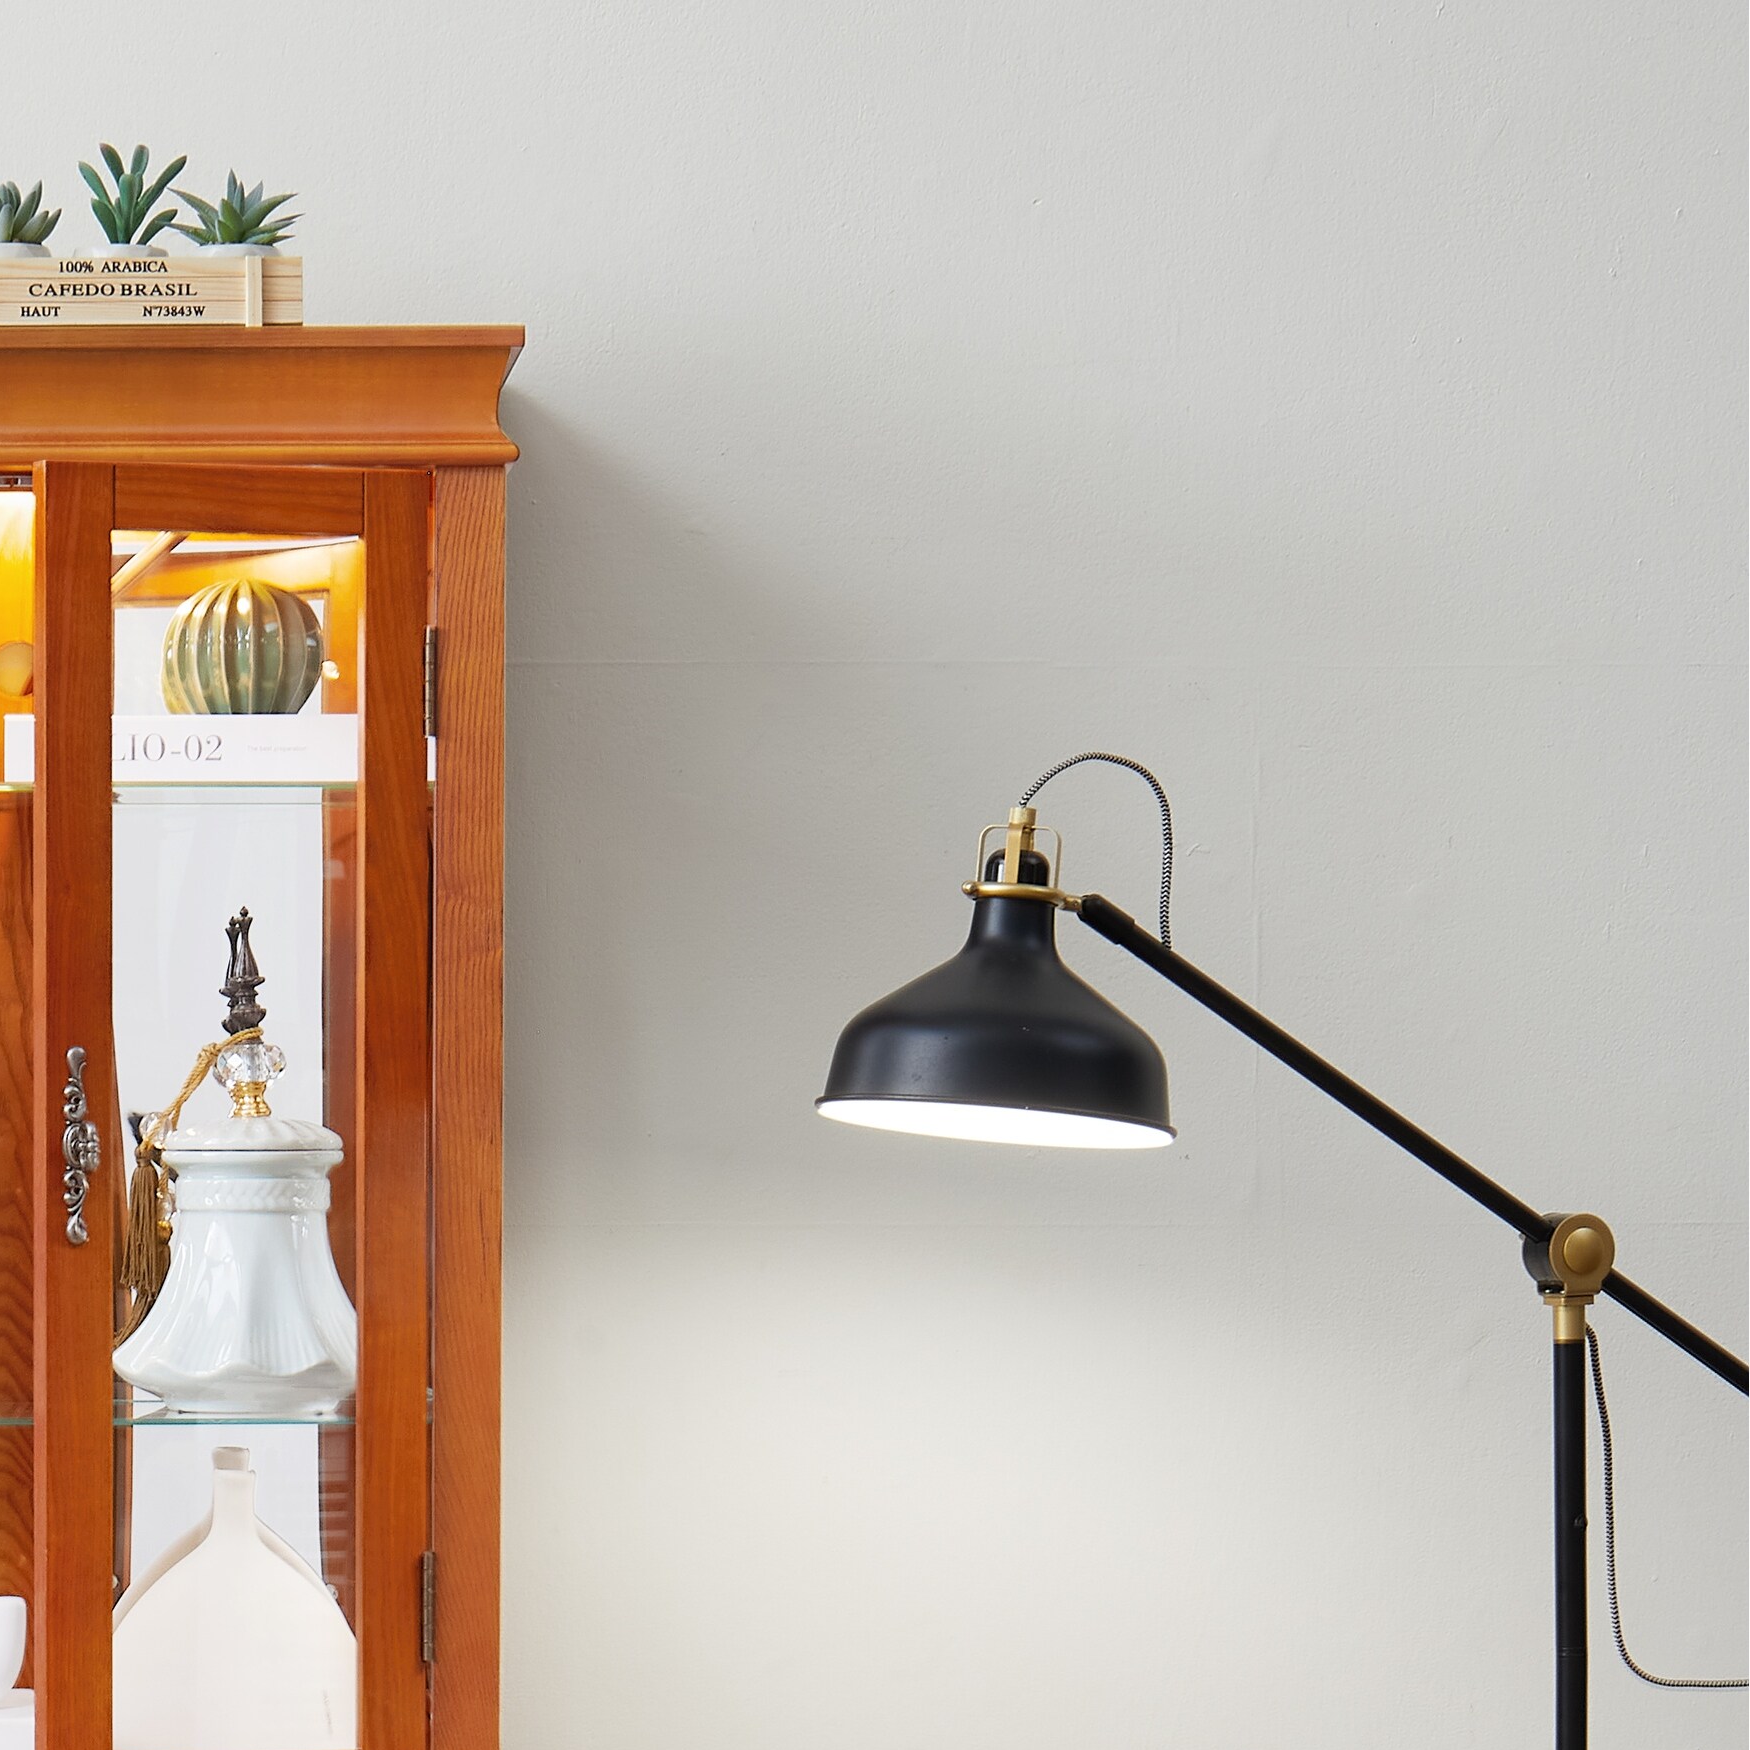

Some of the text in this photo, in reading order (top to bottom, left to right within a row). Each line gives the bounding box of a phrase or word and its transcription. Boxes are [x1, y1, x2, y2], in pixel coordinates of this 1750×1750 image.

[58, 261, 168, 273] 100% ARABICA
[28, 283, 198, 297] CAFEDO BRASIL
[20, 306, 61, 317] HAUT
